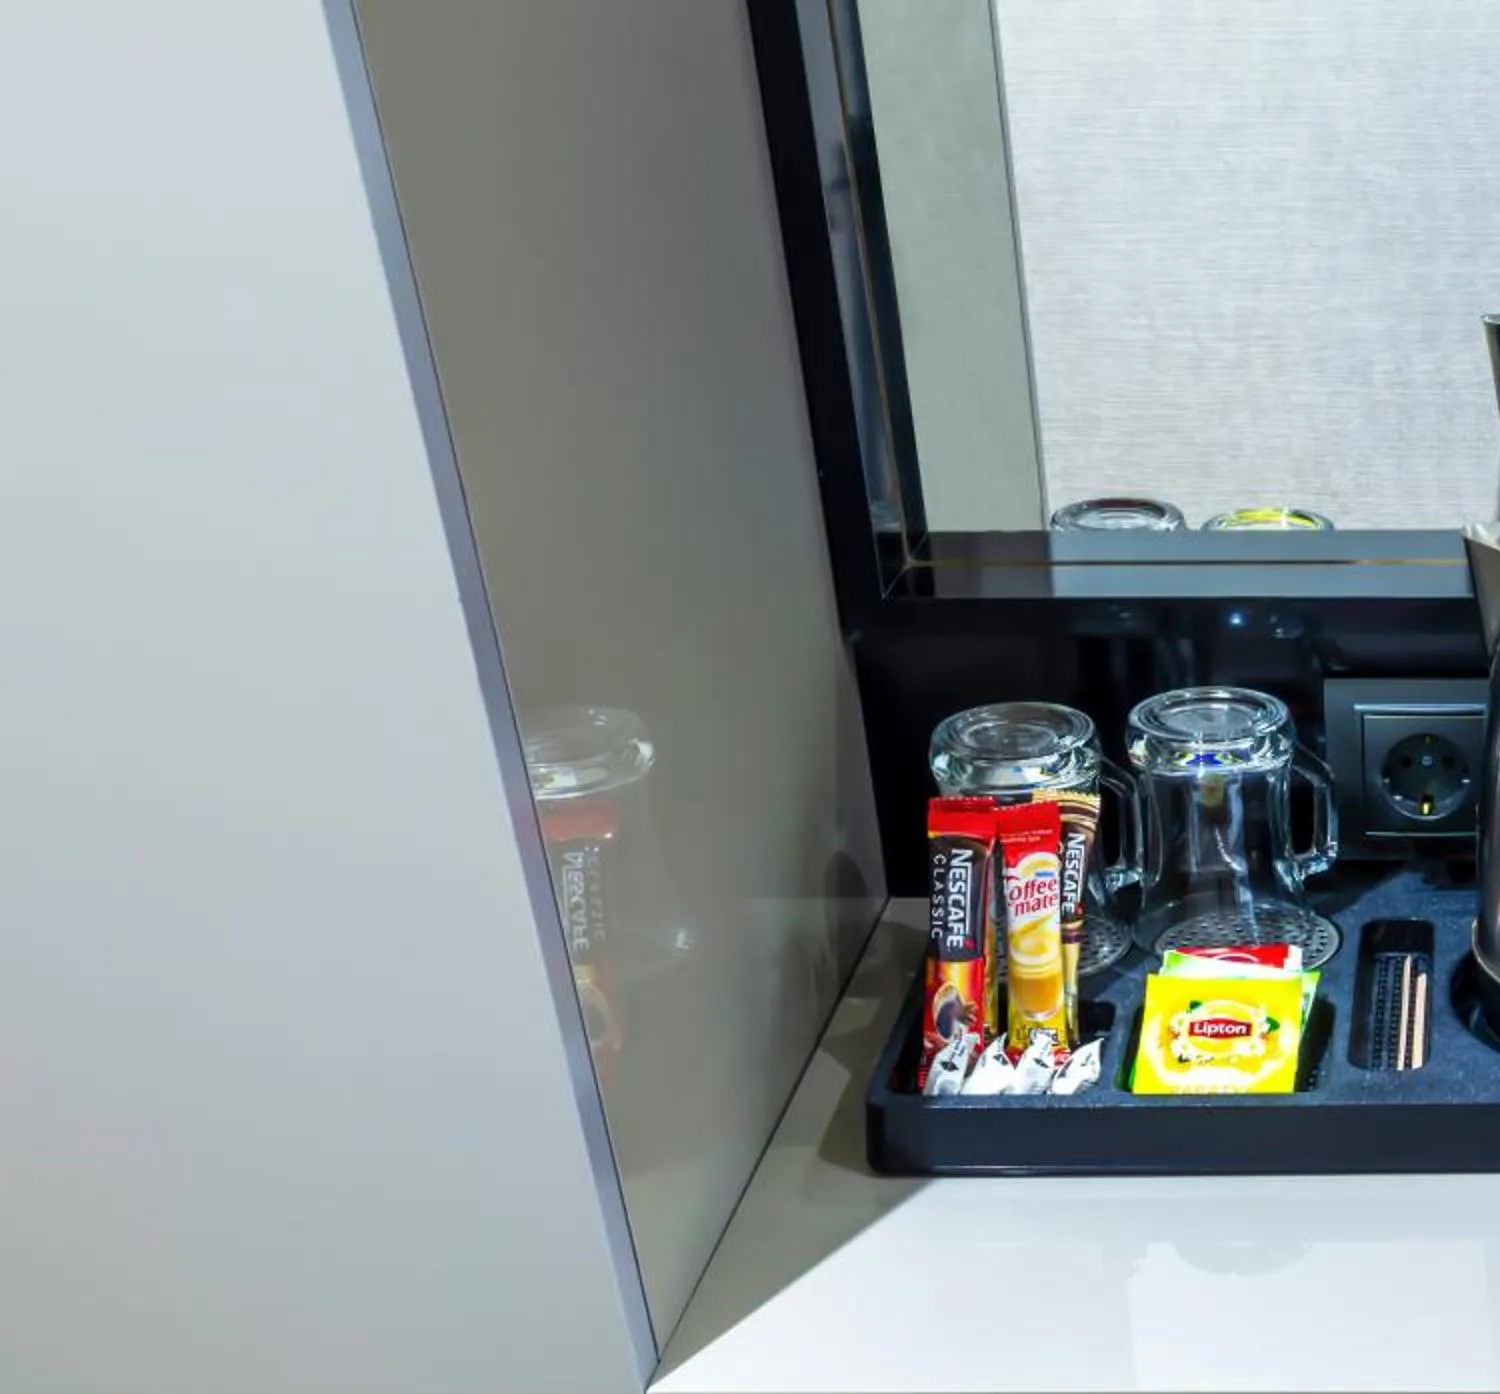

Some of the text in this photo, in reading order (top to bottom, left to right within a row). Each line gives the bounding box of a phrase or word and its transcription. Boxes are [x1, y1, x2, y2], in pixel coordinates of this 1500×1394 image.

[931, 854, 946, 939] CLASSIC
[1015, 894, 1057, 916] mate
[1193, 1019, 1248, 1035] Lipton
